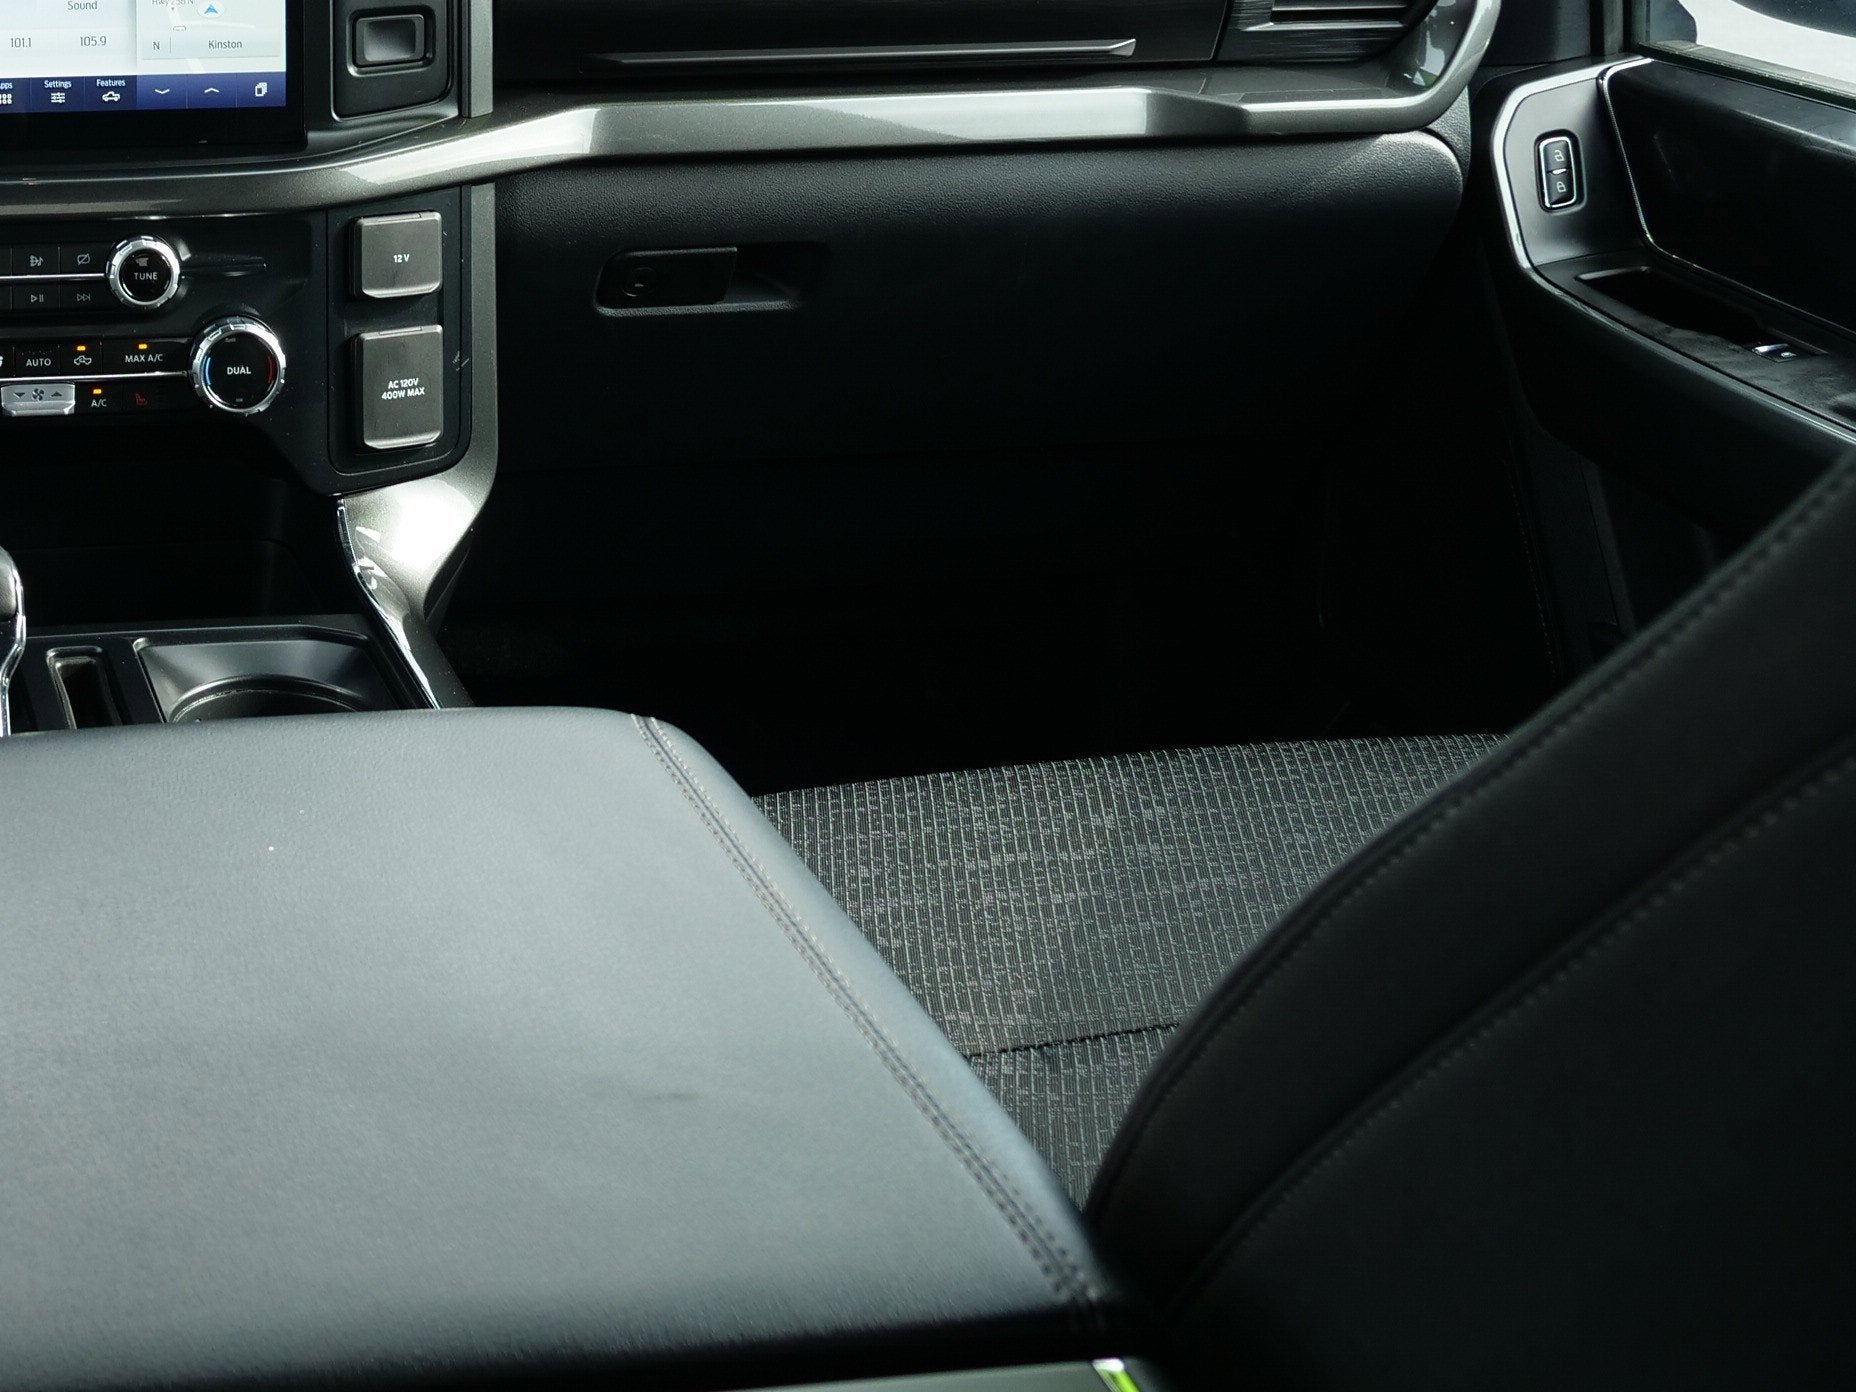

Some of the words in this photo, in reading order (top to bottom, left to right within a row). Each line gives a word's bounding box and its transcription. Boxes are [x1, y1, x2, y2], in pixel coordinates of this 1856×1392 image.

[67, 0, 98, 10] Sound
[10, 37, 32, 48] 101.1
[79, 36, 107, 47] 105.9
[152, 41, 160, 51] N
[208, 39, 243, 50] Kinston
[44, 80, 72, 90] Settings
[96, 79, 126, 87] Features
[133, 272, 158, 281] TUNE
[25, 358, 52, 367] AUTO
[125, 355, 145, 363] MAX
[147, 353, 163, 363] A/C
[226, 366, 252, 375] DUAL
[388, 380, 399, 389] AC
[399, 377, 419, 388] 120V
[381, 390, 406, 400] 400W
[407, 387, 426, 397] MAX
[91, 398, 107, 408] A/C
